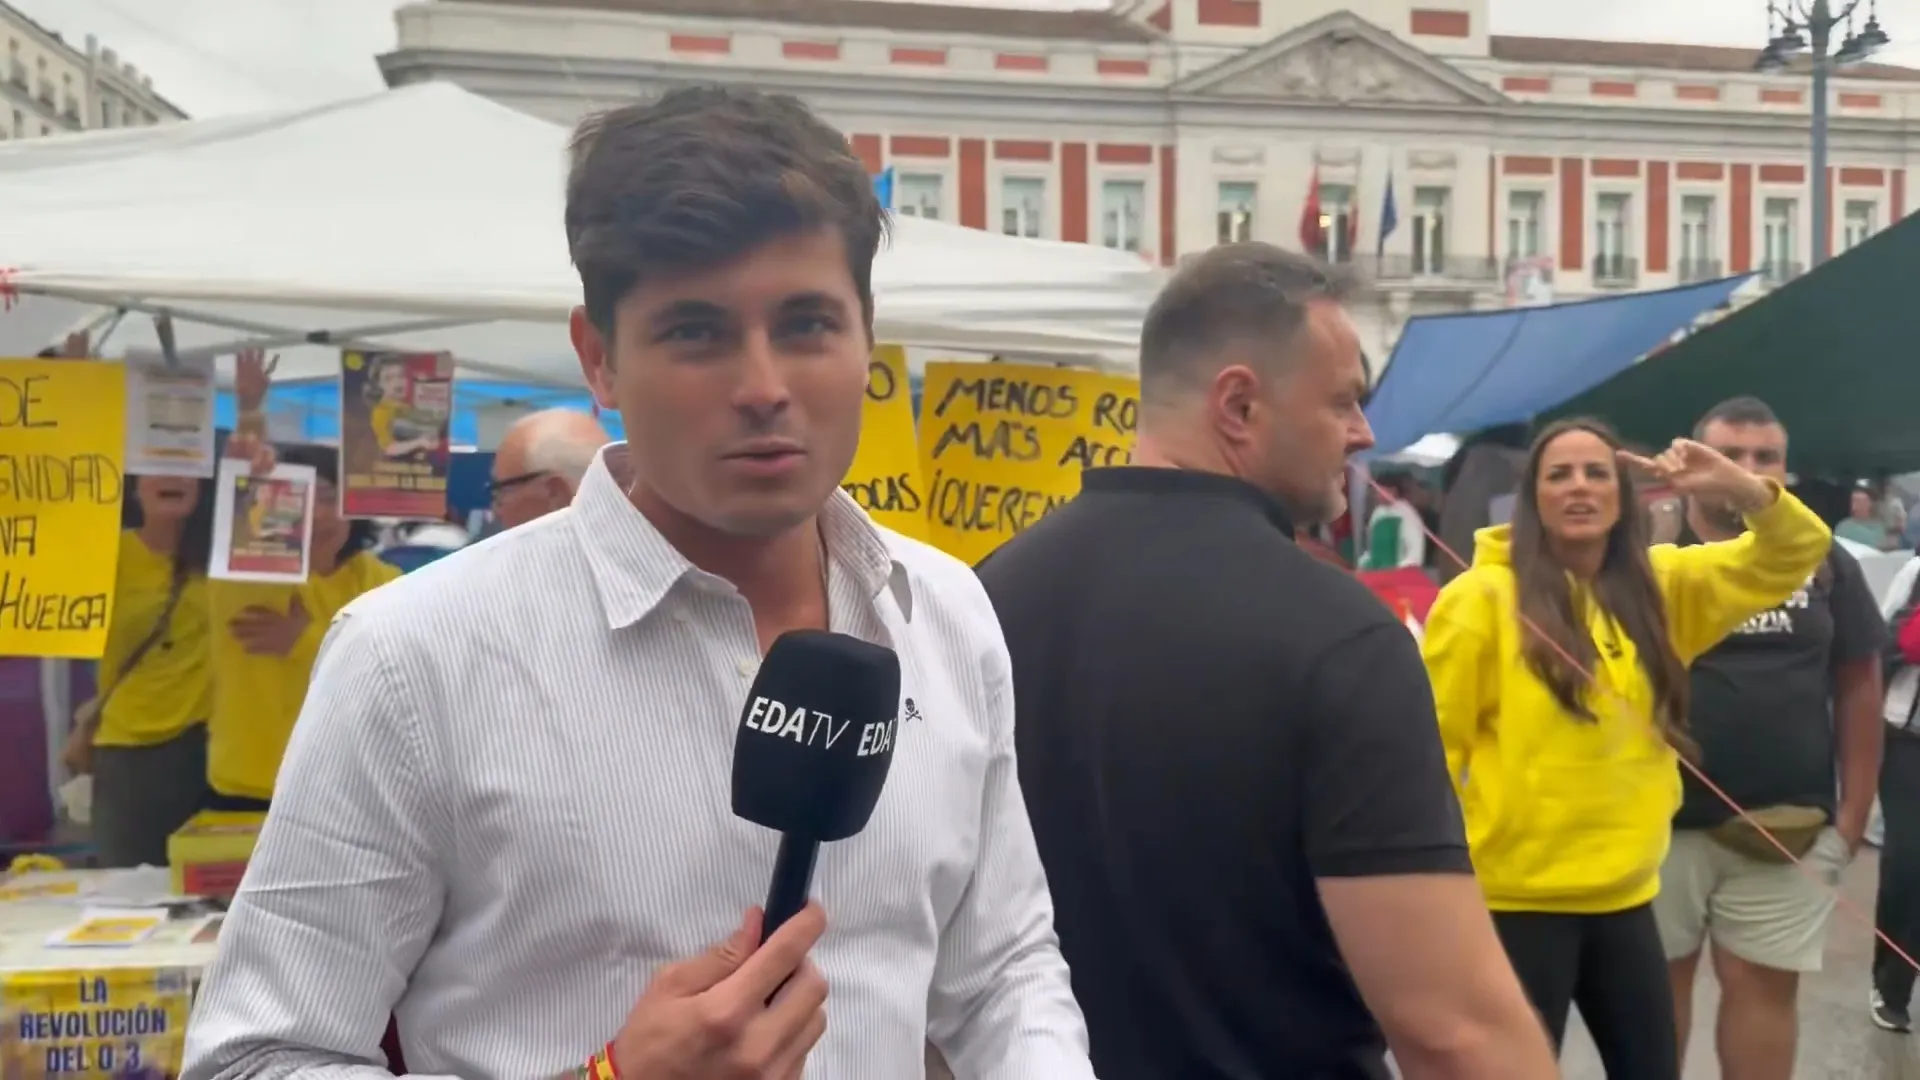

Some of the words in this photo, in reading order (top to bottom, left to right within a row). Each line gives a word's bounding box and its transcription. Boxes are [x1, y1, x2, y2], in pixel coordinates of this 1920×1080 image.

[934, 377, 1079, 418] MENOS
[0, 569, 107, 632] HUELGA
[80, 975, 108, 1003] LA
[20, 1001, 167, 1040] REVOLUCIÓN
[46, 1046, 90, 1073] DEL
